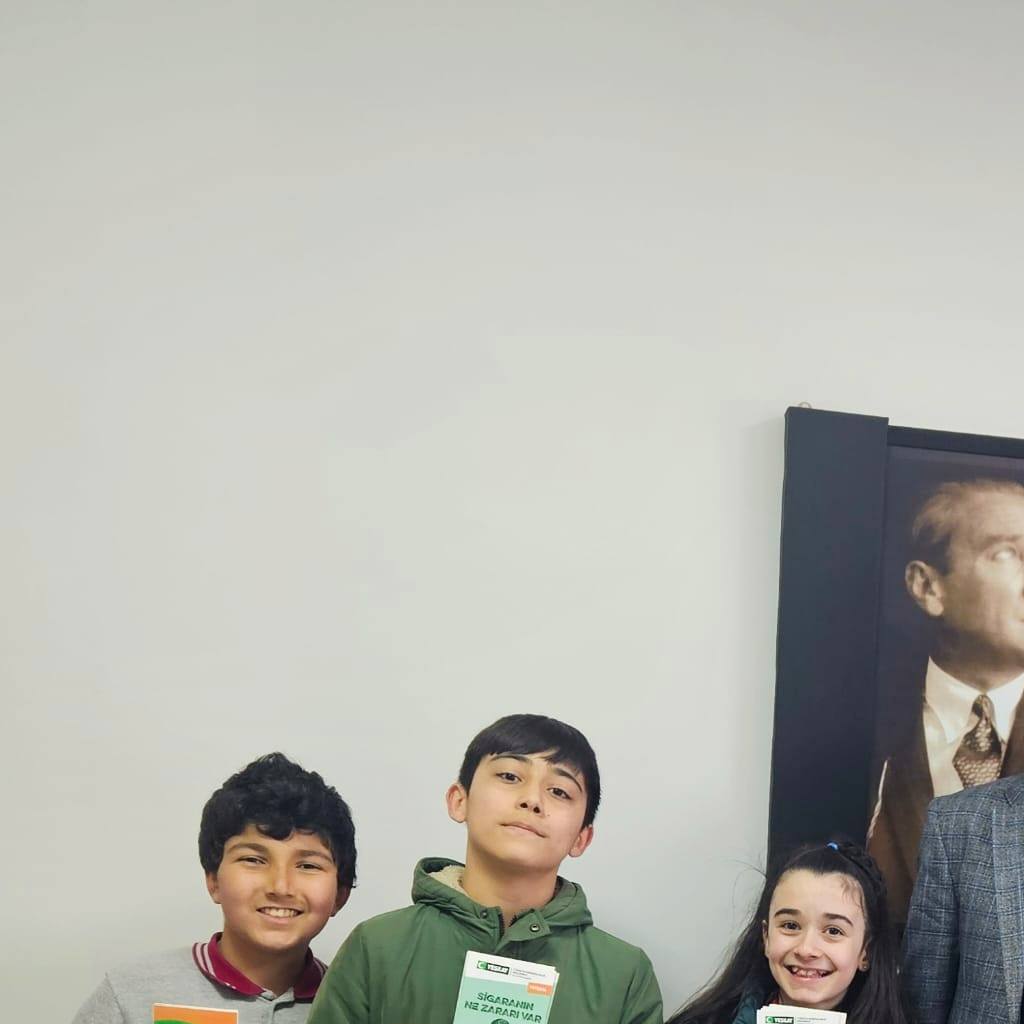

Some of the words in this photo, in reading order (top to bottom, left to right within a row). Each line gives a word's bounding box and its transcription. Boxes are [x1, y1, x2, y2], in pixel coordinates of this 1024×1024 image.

[464, 1000, 479, 1011] NE
[481, 1004, 520, 1019] ZARARI
[521, 1013, 542, 1024] VAR
[477, 992, 535, 1011] SİGARANIN
